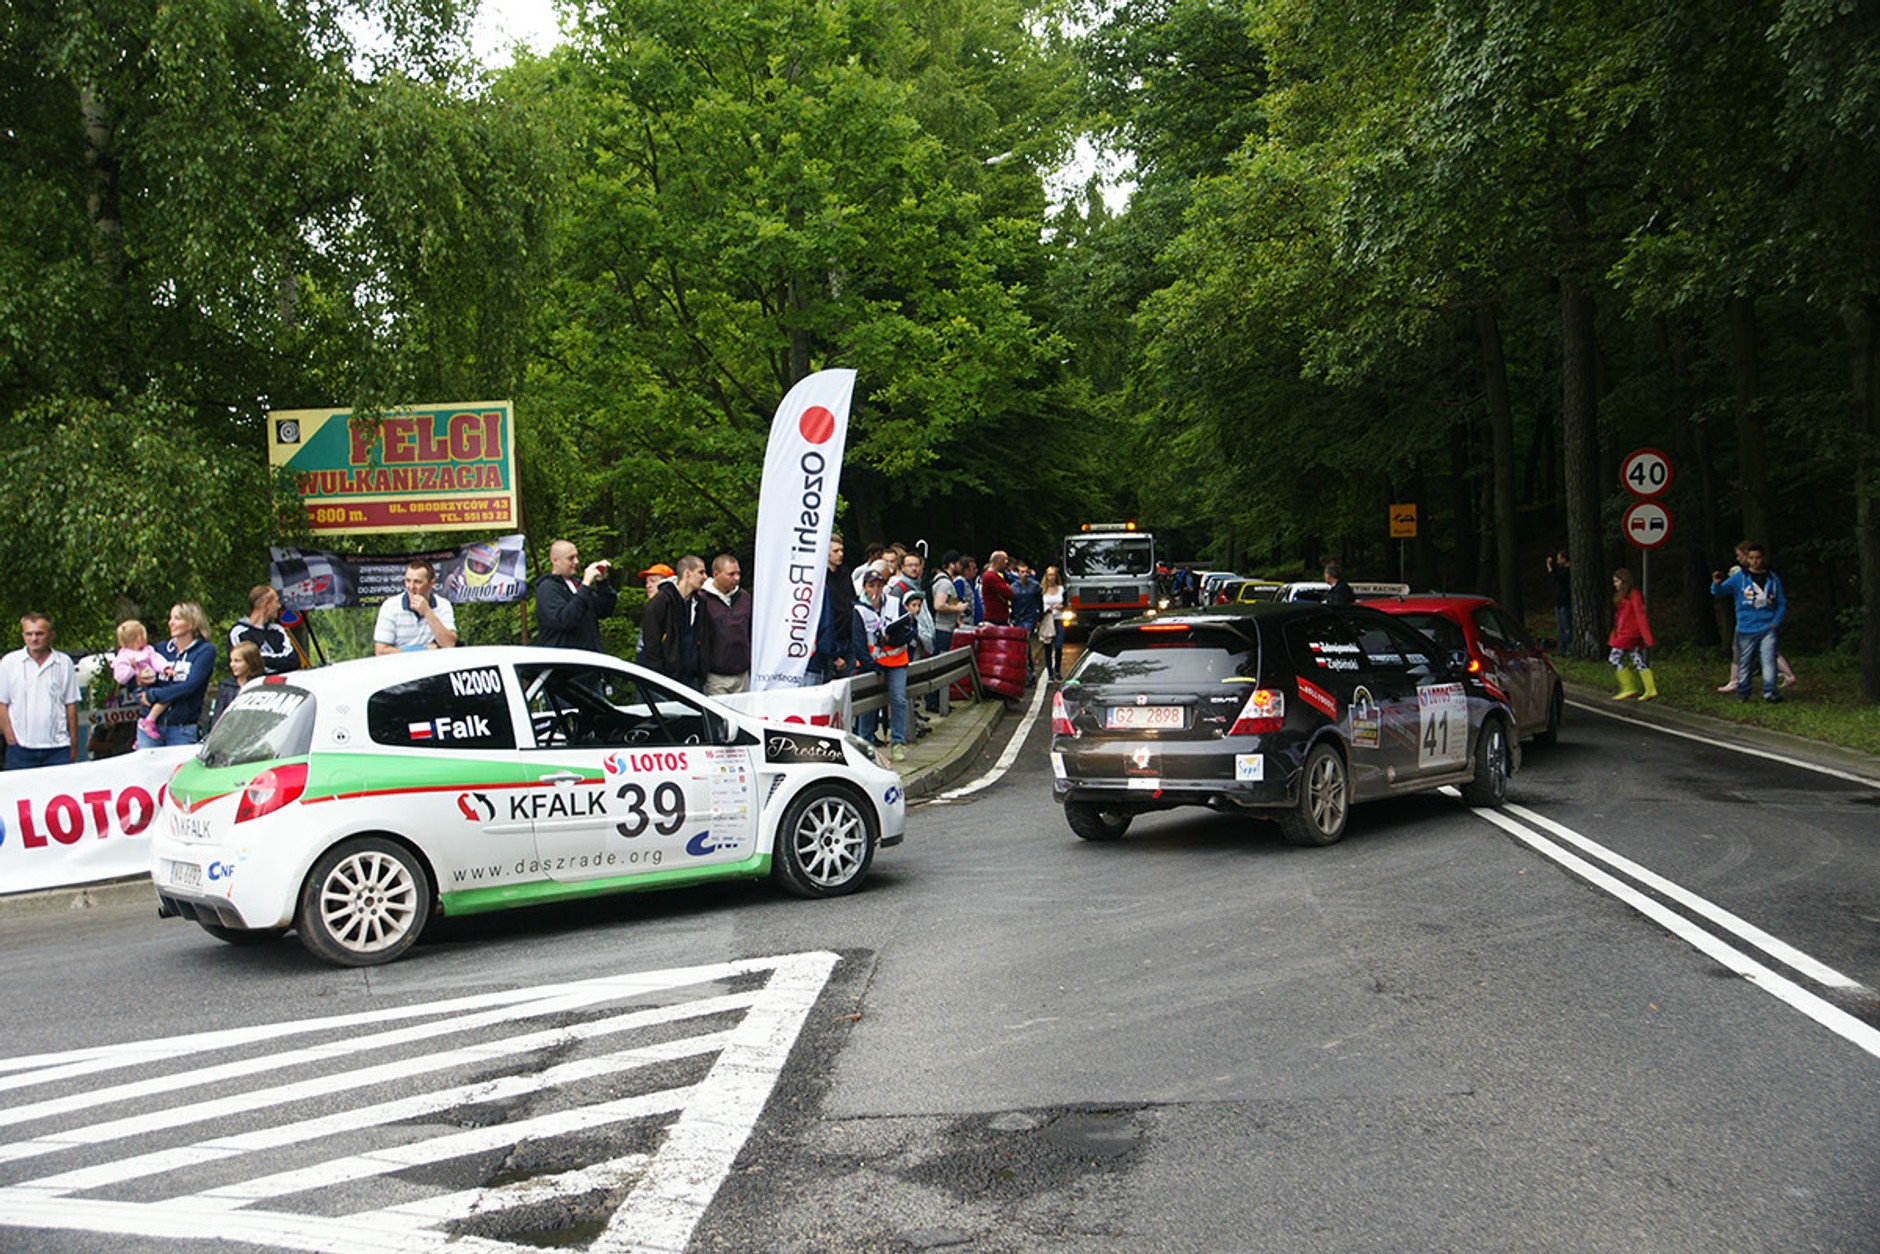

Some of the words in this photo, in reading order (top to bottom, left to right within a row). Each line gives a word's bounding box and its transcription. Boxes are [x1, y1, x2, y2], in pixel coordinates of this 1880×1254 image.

[1629, 462, 1665, 485] 40
[316, 507, 346, 523] 800
[349, 509, 368, 522] m.
[492, 499, 509, 510] 43
[449, 670, 501, 698] N2000
[435, 715, 491, 740] Falk
[1115, 708, 1134, 724] G2
[1146, 707, 1181, 723] 2898
[1423, 711, 1450, 756] 41
[766, 736, 844, 760] Prestige
[631, 752, 688, 773] LOTOS
[510, 791, 607, 821] KFALK
[616, 781, 686, 838] 39
[453, 848, 664, 883] www.daszrade.org
